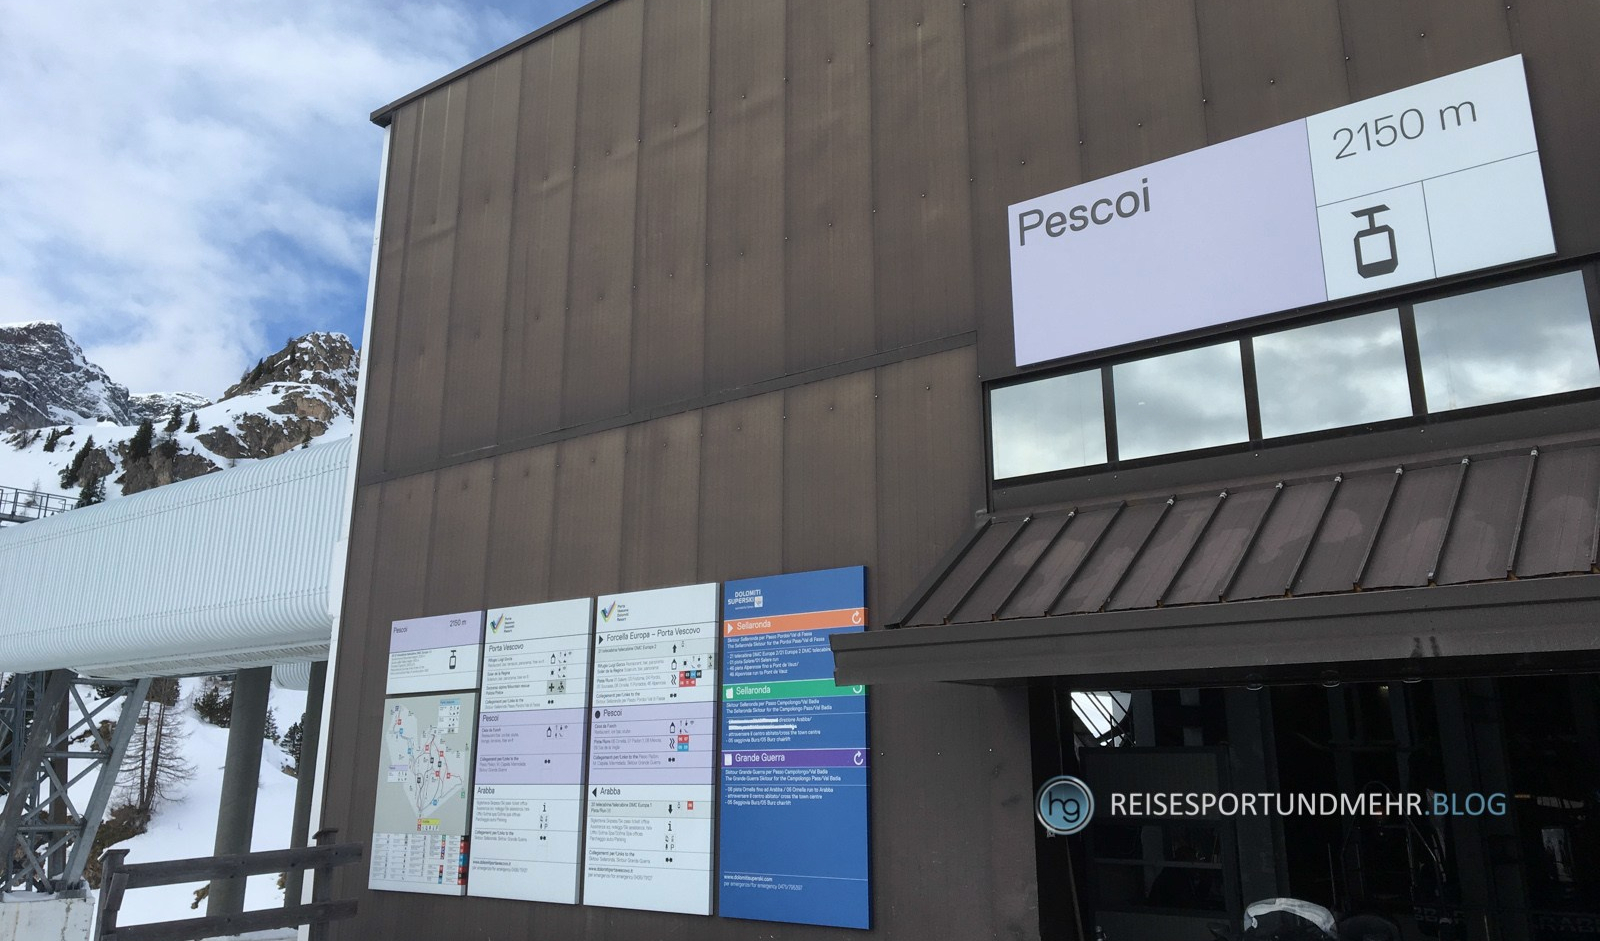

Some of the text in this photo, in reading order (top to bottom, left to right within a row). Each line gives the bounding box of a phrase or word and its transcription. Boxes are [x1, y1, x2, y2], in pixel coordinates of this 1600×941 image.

[1332, 100, 1478, 160] 2150 m
[1018, 178, 1152, 246] Pescoi
[735, 589, 761, 597] DOLOMITI
[728, 597, 754, 605] SUPERSKI
[450, 619, 461, 627] 2150
[737, 620, 771, 630] Sellaronda
[607, 633, 628, 641] Forcella
[630, 631, 650, 640] Europa
[657, 629, 673, 637] Porta
[736, 686, 771, 695] Sellaronda
[603, 709, 622, 717] Pescoi
[735, 753, 785, 762] Grande Guerra
